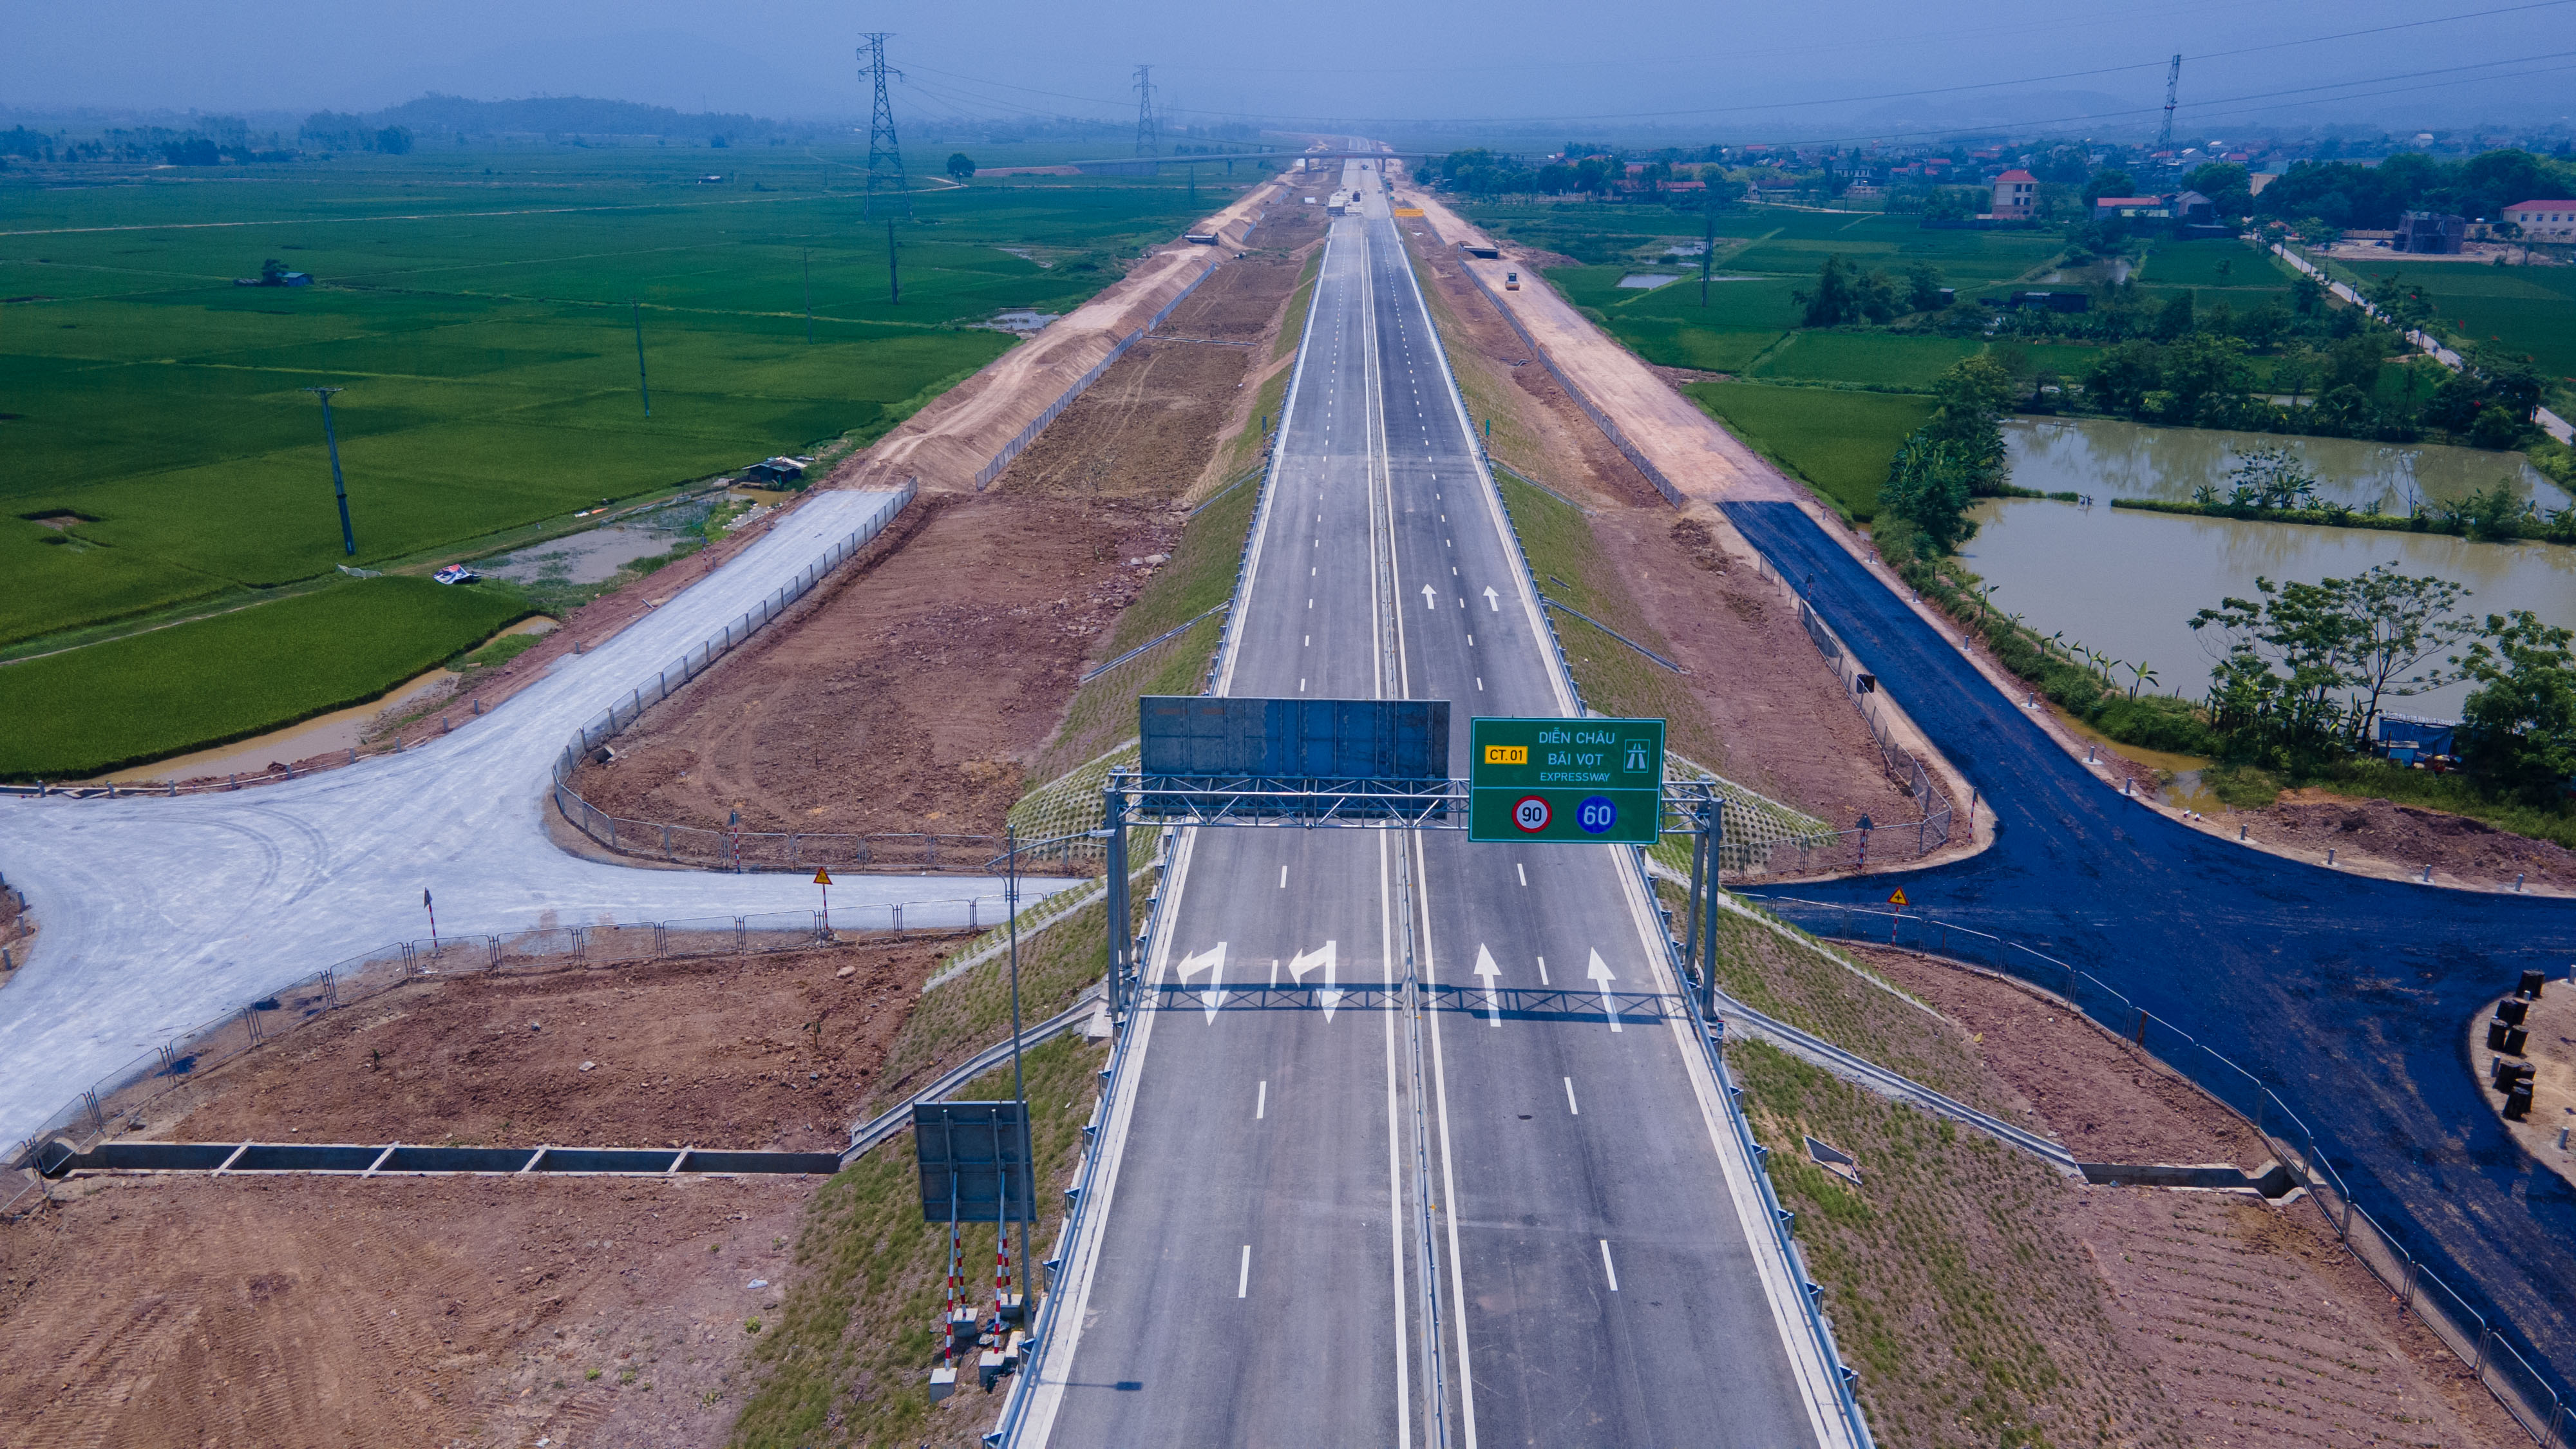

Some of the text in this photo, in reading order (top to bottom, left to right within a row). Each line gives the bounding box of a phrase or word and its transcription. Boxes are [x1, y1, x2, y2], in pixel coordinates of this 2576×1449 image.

[1539, 727, 1615, 744] DIỄN CHÂU
[1548, 751, 1604, 768] BÃI VỌT
[1540, 772, 1611, 782] EXPRESSWAY
[1522, 806, 1542, 822] 90
[1584, 806, 1611, 825] 60
